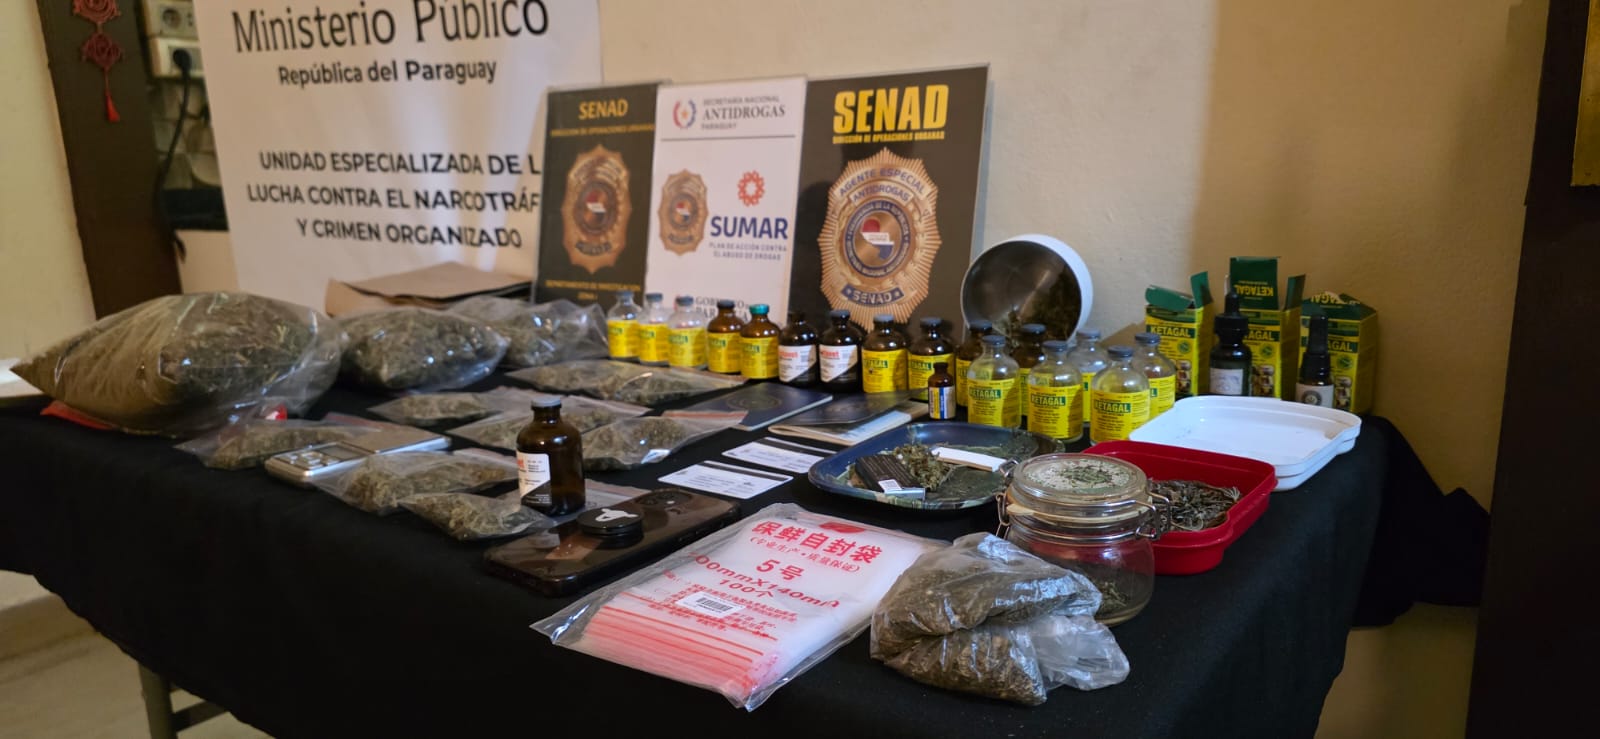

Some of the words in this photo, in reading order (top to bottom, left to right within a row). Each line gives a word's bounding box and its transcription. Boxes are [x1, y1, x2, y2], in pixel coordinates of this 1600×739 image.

[232, 1, 396, 53] Ministerio
[278, 63, 363, 89] República
[368, 61, 398, 83] del
[405, 60, 497, 84] Paraguay
[578, 98, 628, 120] SENAD
[703, 104, 785, 121] ANTIDROGAS
[832, 84, 949, 134] SENAD
[259, 151, 327, 171] UNIDAD
[331, 152, 482, 175] ESPECIALIZADA
[488, 154, 521, 175] DE
[528, 155, 541, 175] L
[840, 168, 876, 196] AGENTE
[880, 168, 925, 194] ESPECIAL
[853, 184, 911, 202] ANTIDROGAS
[247, 184, 303, 205] LUCHA
[308, 186, 382, 207] CONTRA
[387, 188, 409, 209] EL
[415, 187, 540, 213] NARCOTRÁF
[296, 218, 307, 237] Y
[313, 219, 381, 242] CRIMEN
[386, 223, 522, 249] ORGANIZADO
[710, 216, 789, 239] SUMAR
[853, 290, 893, 304] SENAD
[1234, 284, 1274, 296] KETAGAL
[1151, 325, 1191, 337] KETAGAL
[1247, 329, 1275, 340] AGAL
[1328, 340, 1353, 352] AGAL
[752, 520, 882, 563] 保鲜自封袋
